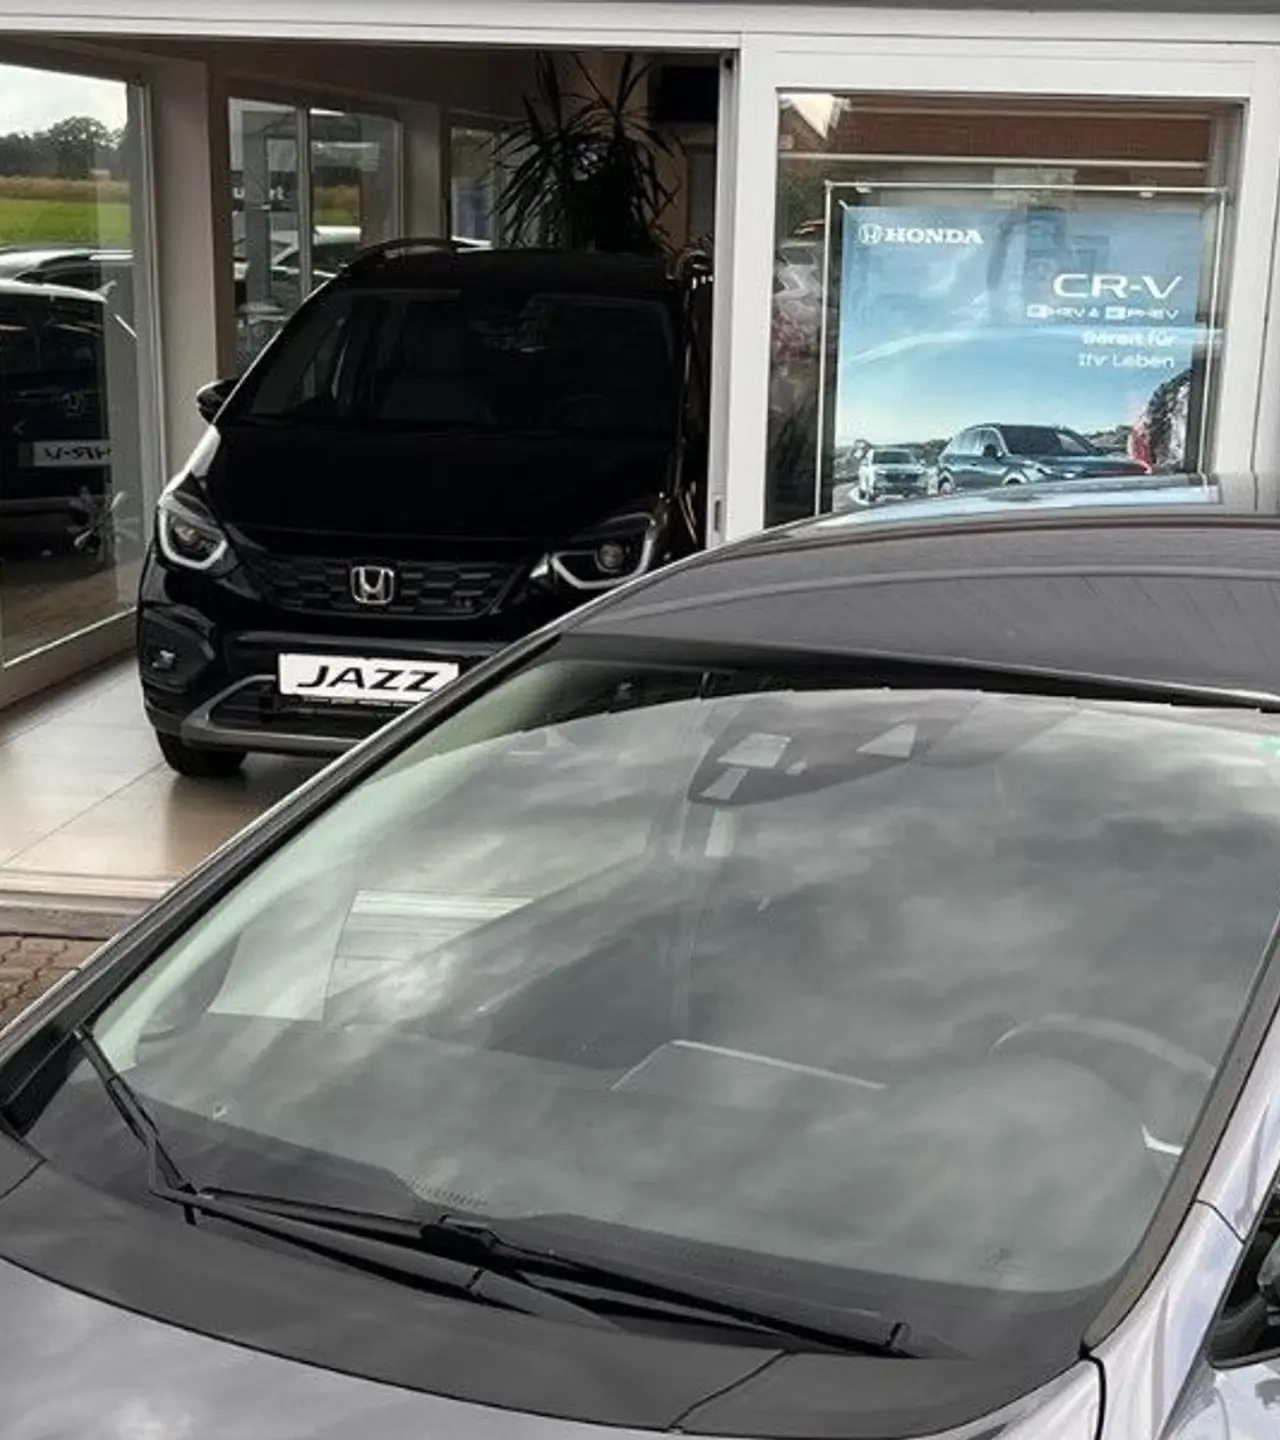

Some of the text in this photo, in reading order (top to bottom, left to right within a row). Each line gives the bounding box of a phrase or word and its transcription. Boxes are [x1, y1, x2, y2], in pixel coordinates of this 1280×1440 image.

[883, 226, 985, 246] HONDA
[1052, 272, 1183, 300] CR-V
[1112, 351, 1175, 368] Leben
[296, 664, 440, 693] JAZZ
